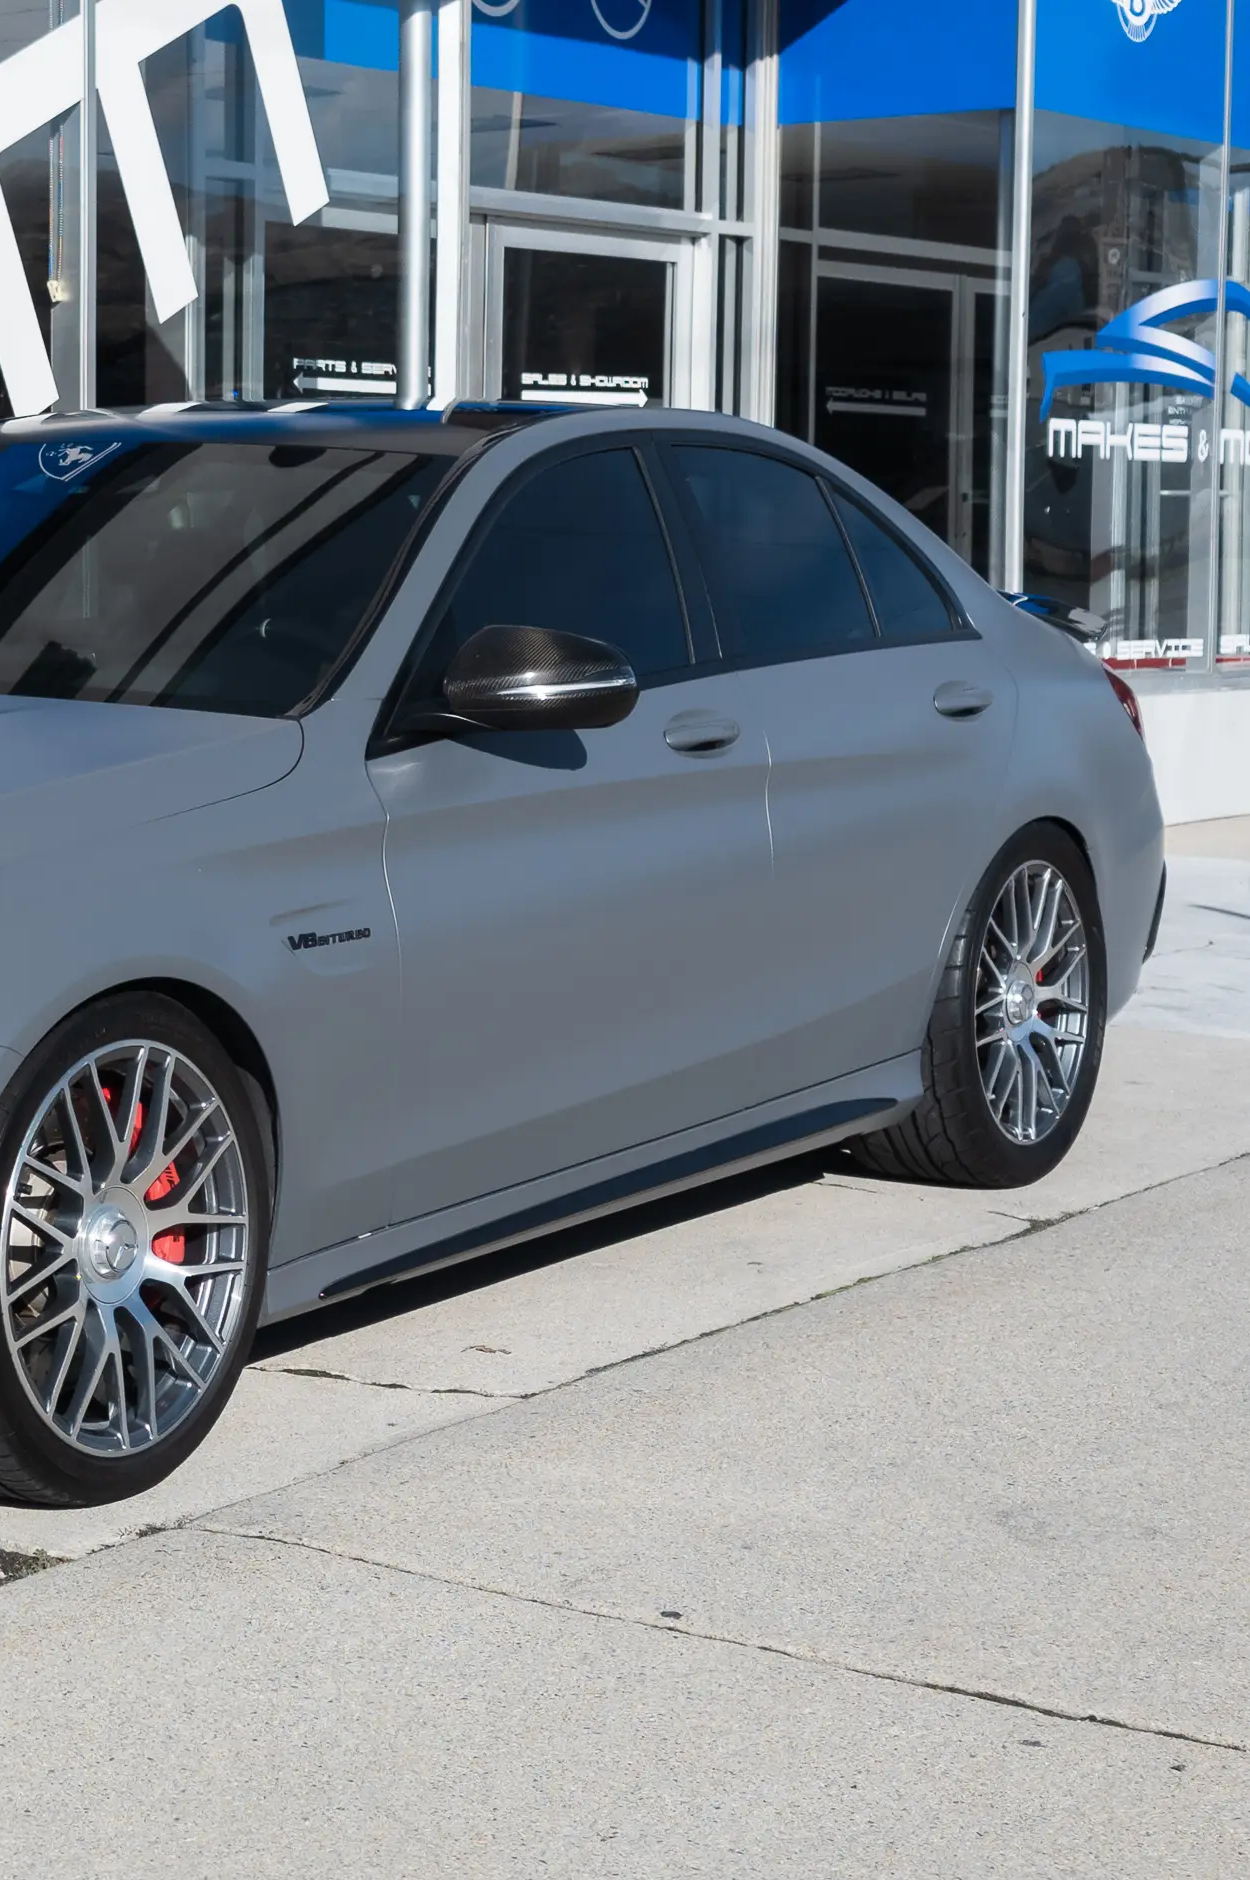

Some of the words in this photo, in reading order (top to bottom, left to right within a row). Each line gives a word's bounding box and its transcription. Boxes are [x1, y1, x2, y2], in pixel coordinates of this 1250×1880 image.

[293, 358, 347, 373] PARTS
[351, 361, 357, 373] &
[521, 373, 567, 386] SALES
[579, 374, 649, 388] SHOWROOM
[1048, 418, 1189, 463] MAKES
[1198, 429, 1209, 462] &
[1116, 638, 1204, 660] SERVICE
